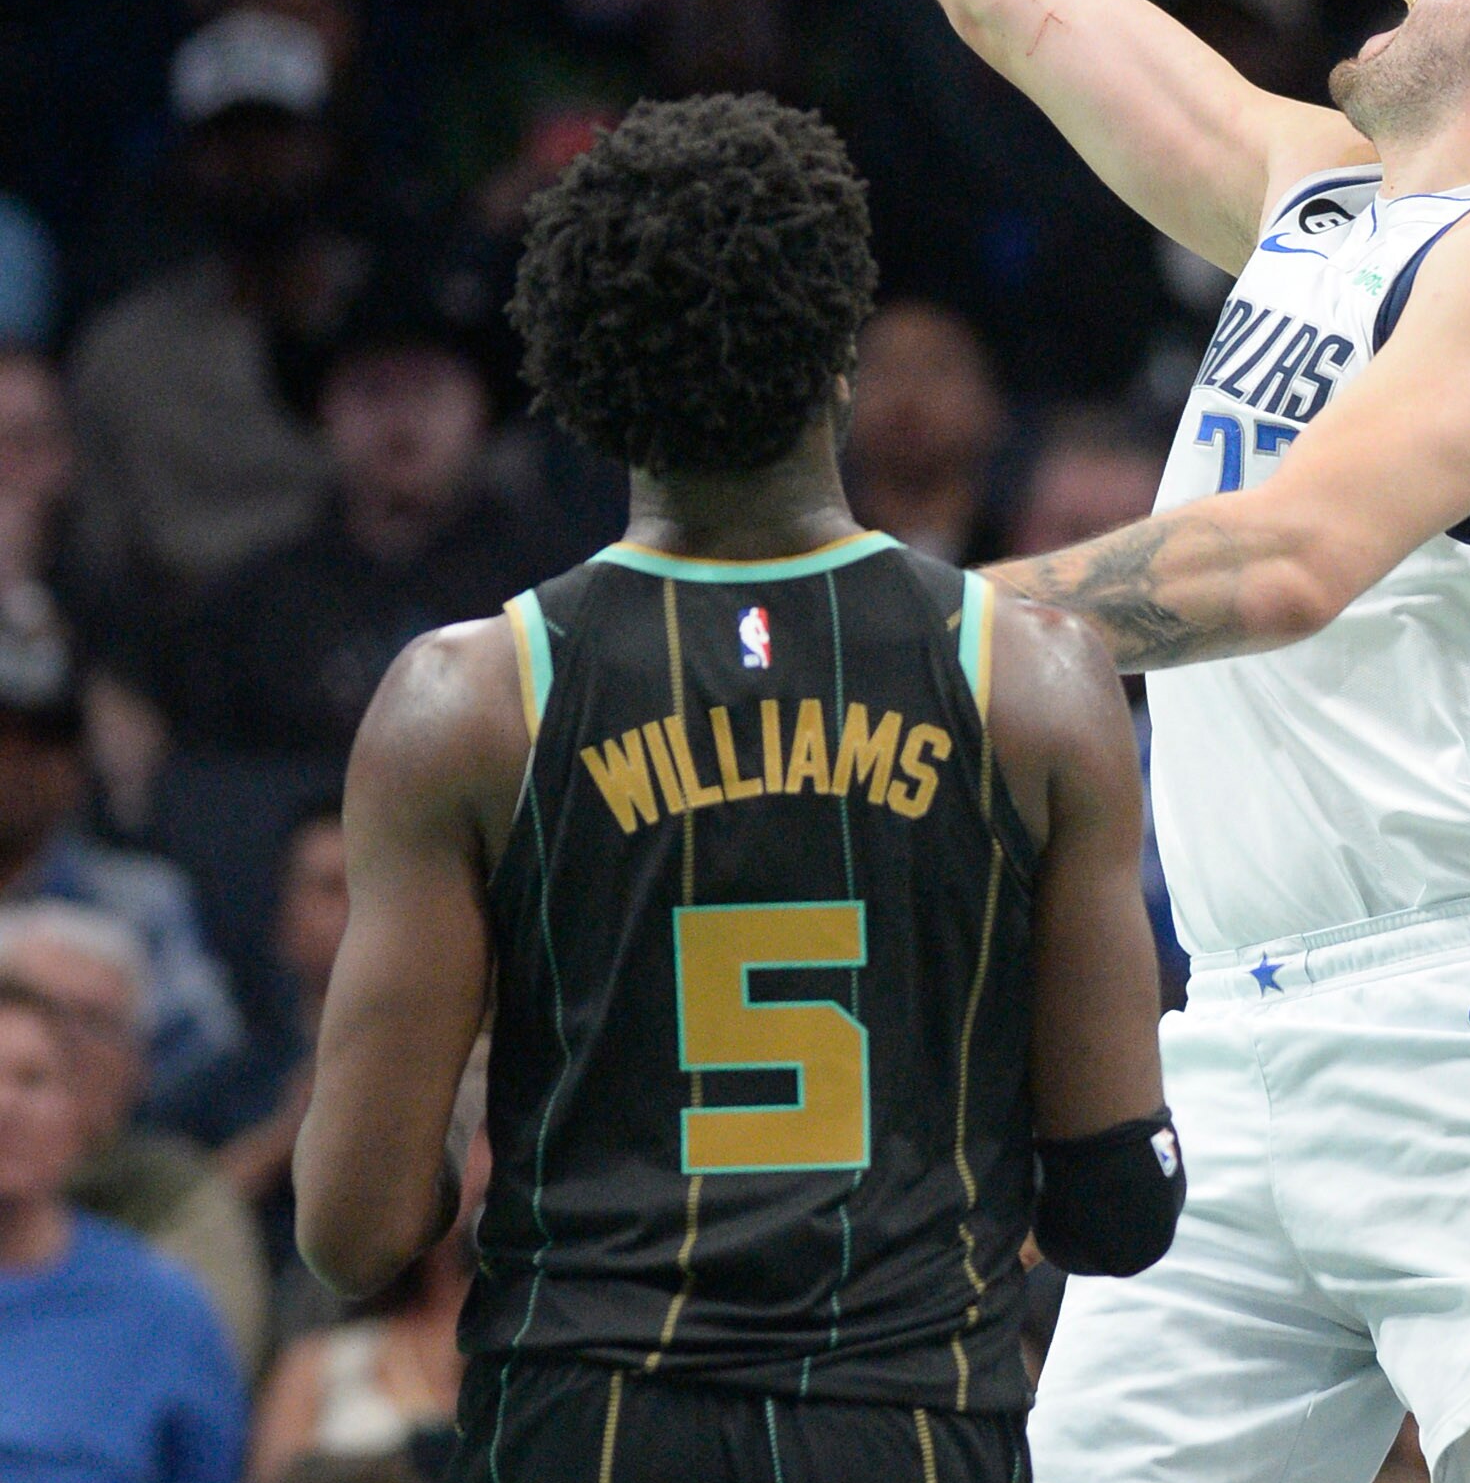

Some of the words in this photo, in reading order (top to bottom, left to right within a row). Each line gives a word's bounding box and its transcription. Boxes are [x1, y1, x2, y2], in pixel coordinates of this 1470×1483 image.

[1192, 296, 1357, 425] ALLAS
[579, 698, 953, 834] WILLIAMS
[673, 900, 872, 1175] 5
